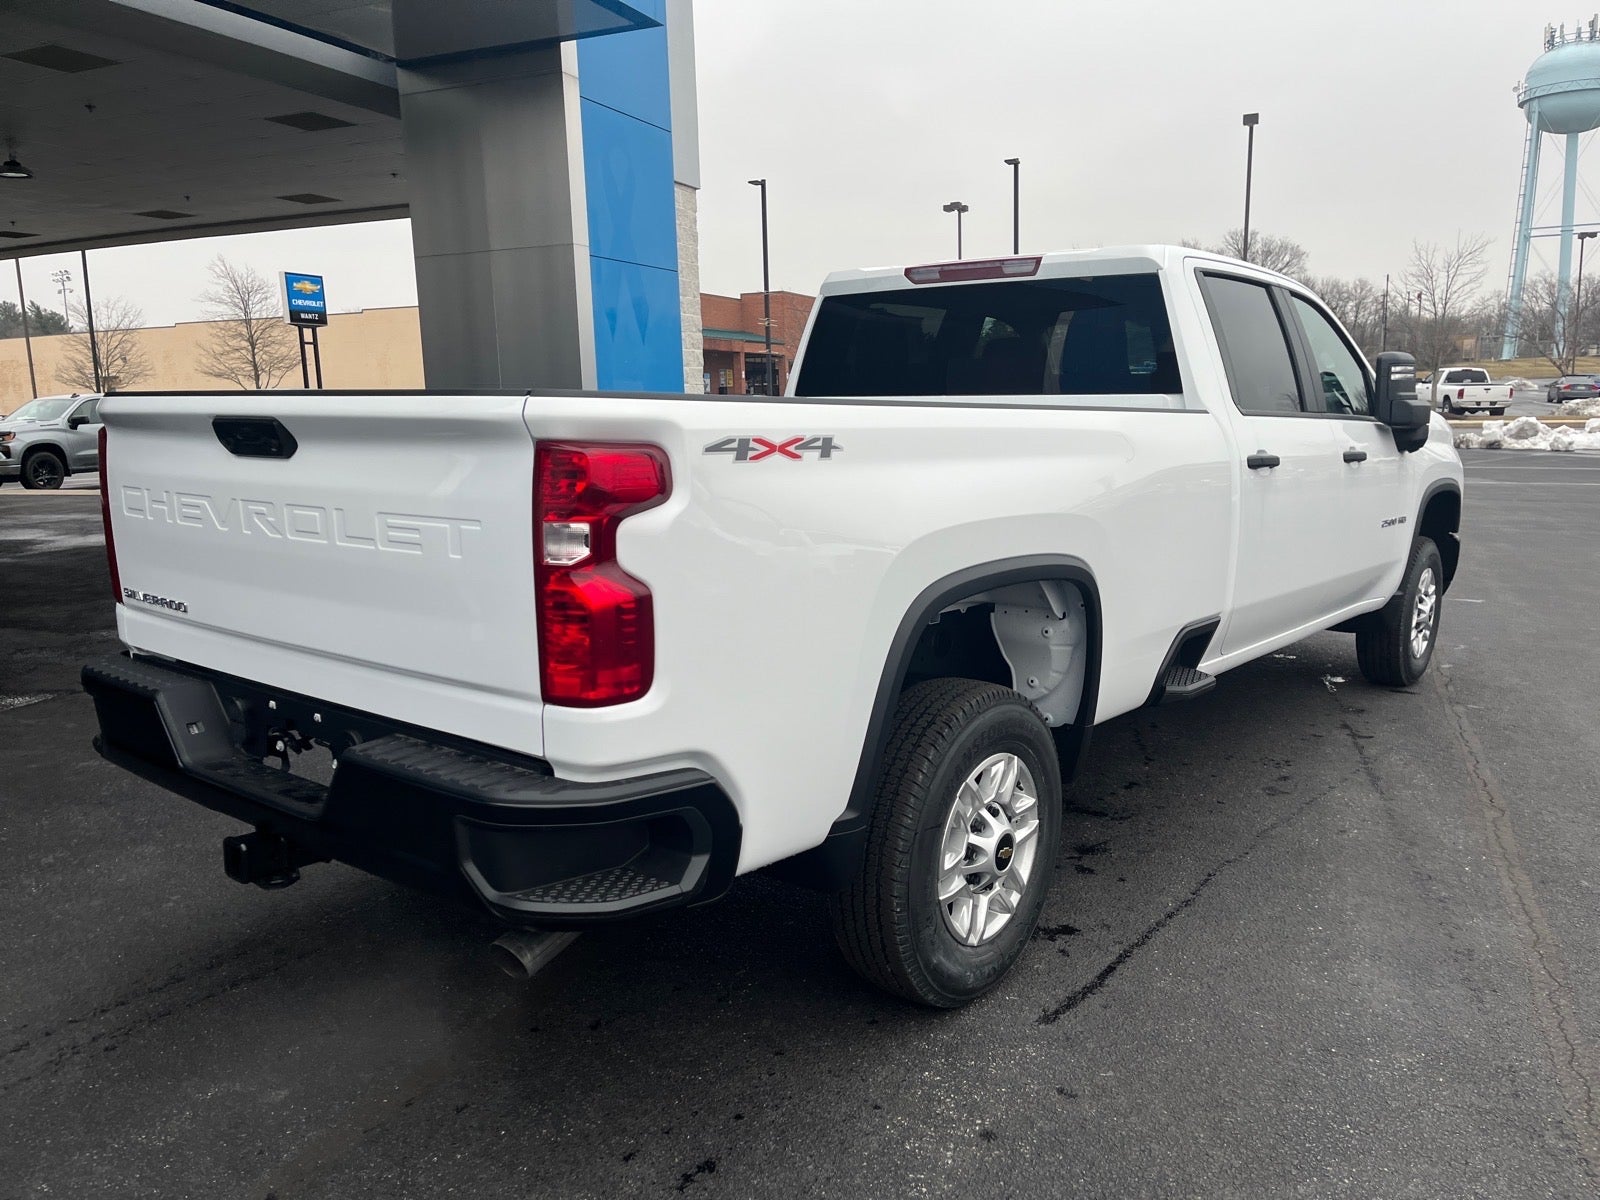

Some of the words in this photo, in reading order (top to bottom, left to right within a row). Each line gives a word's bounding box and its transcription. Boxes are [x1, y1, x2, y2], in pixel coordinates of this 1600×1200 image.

[292, 299, 324, 307] CHEVROLET
[122, 485, 481, 559] CHEVROLET
[123, 587, 188, 613] SILVERADO
